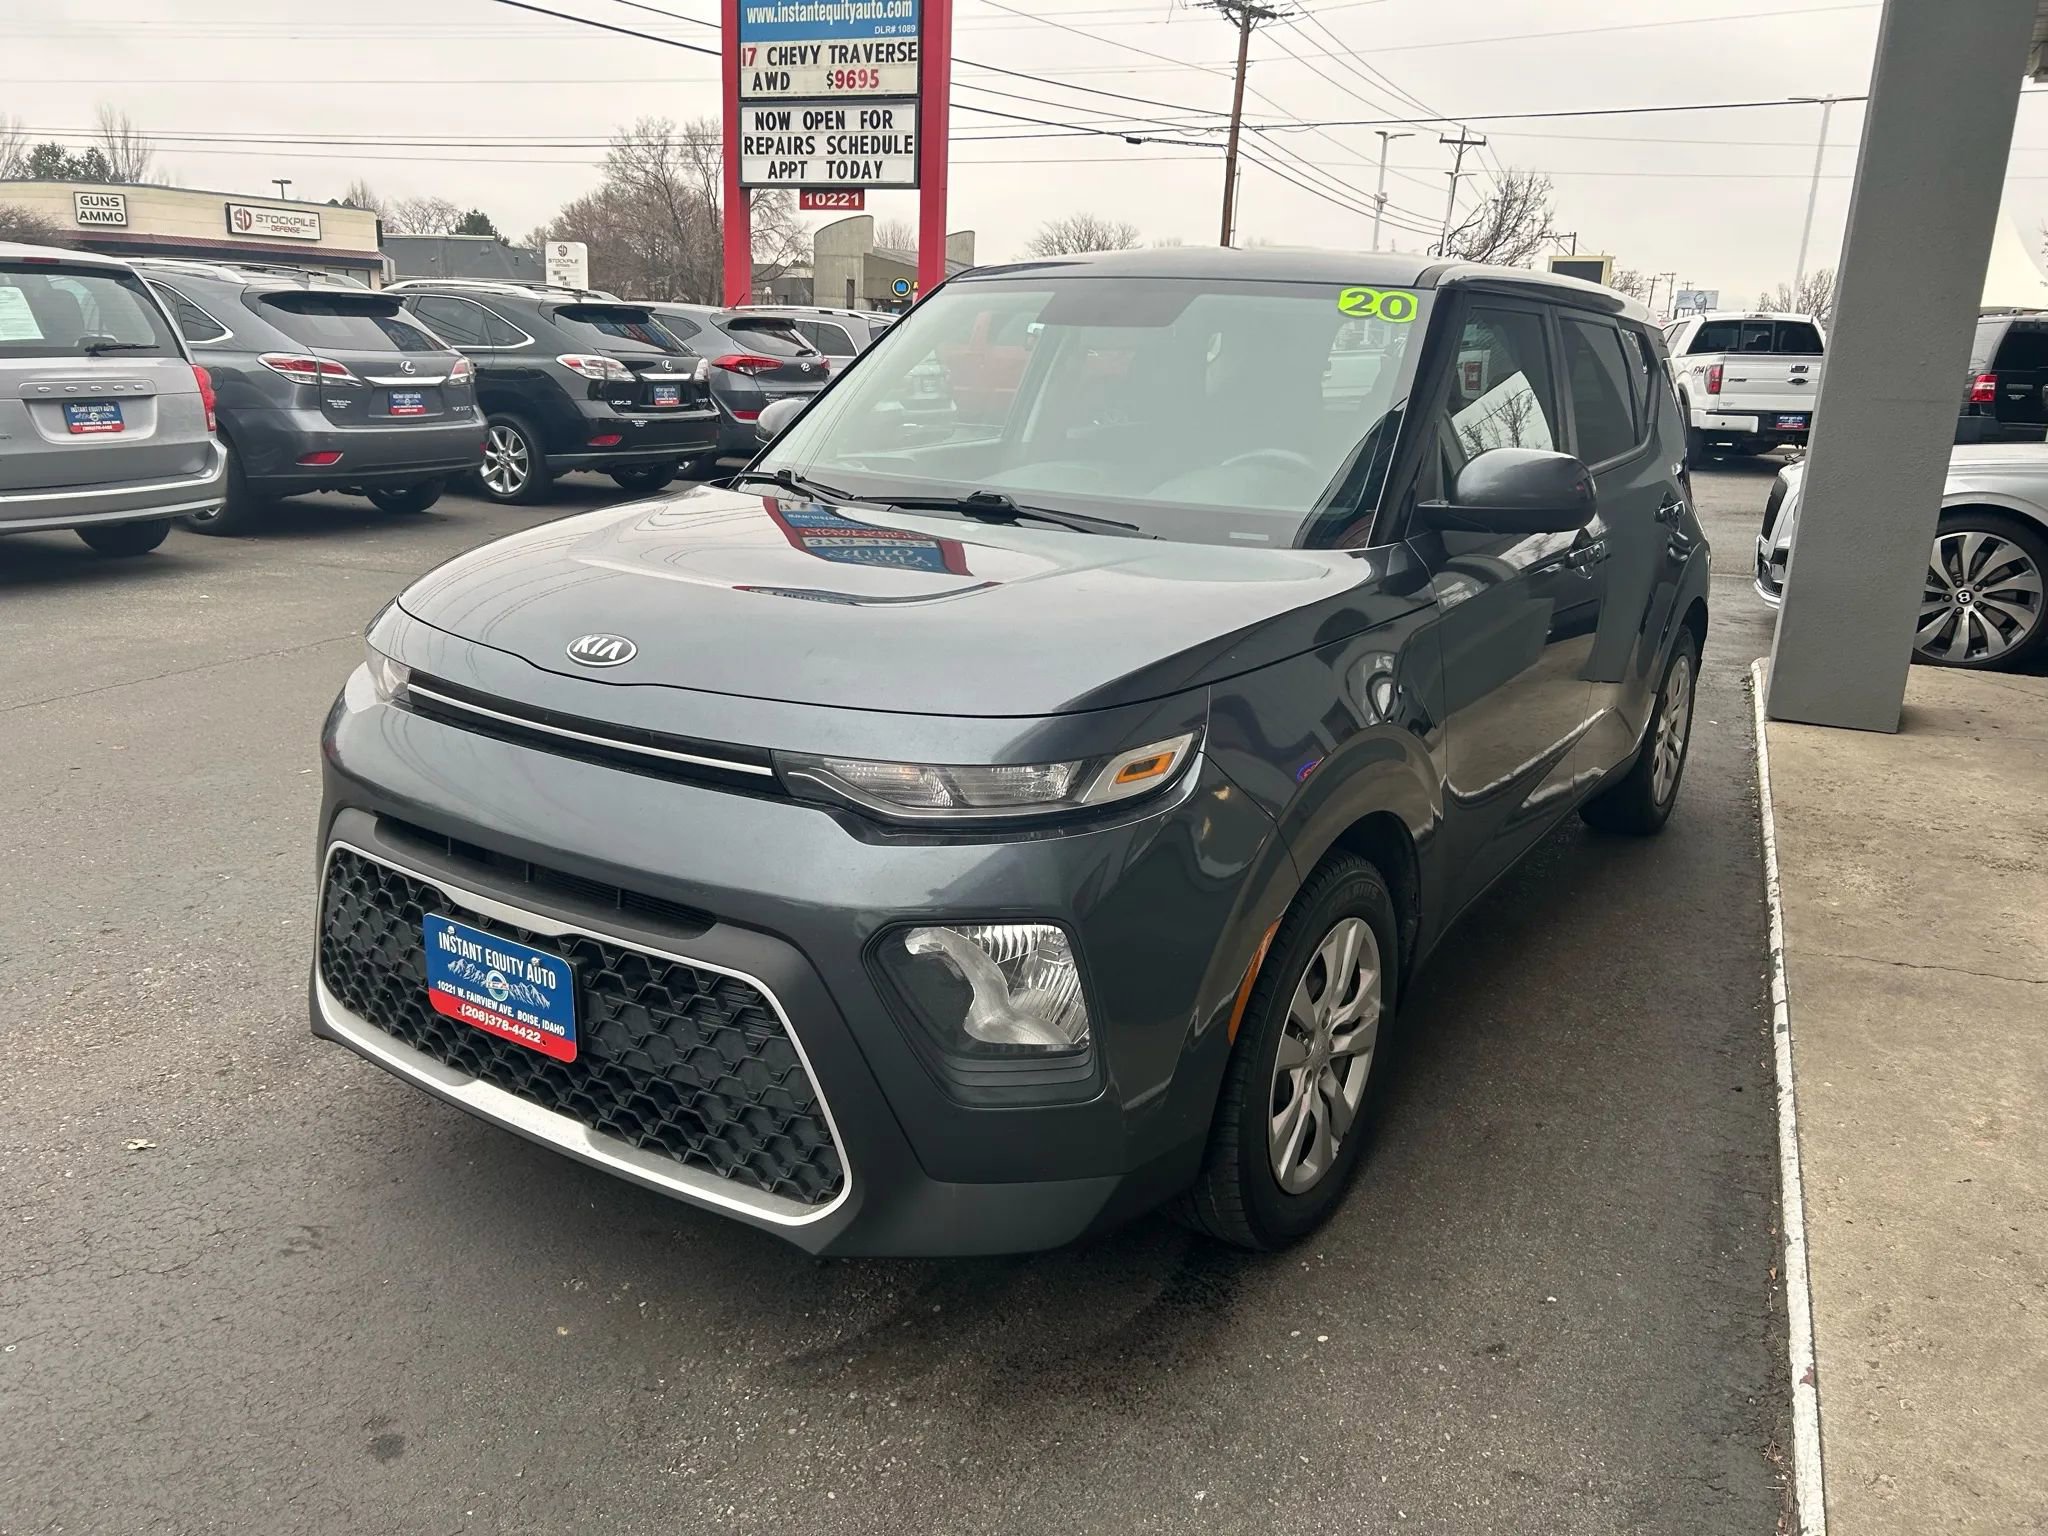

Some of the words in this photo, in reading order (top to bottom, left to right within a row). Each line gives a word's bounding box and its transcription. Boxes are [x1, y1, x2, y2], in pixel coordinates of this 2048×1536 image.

[747, 0, 912, 25] www.instantequityauto.com
[874, 25, 896, 35] DLR#
[898, 24, 916, 33] 1089
[742, 47, 757, 67] 17
[767, 44, 821, 67] CHEVY
[828, 41, 917, 64] TRAVERSE
[752, 71, 791, 91] AWD
[826, 68, 880, 90] $9695
[755, 111, 791, 131] NOW
[802, 110, 846, 130] OPEN
[860, 109, 893, 129] FOR
[744, 135, 816, 155] REPAIRS
[826, 135, 914, 155] SCHEDULE
[767, 160, 808, 179] APPT
[826, 160, 883, 179] TODAY
[80, 195, 120, 207] GUNS
[805, 192, 859, 206] 10221
[79, 210, 124, 222] AMMO
[255, 213, 316, 228] STOCKPILE
[271, 225, 300, 233] DEFENSE
[1344, 290, 1413, 320] 20
[572, 635, 623, 661] KIA
[438, 931, 482, 963] INSTANT
[485, 947, 524, 977] EQUITY
[526, 962, 556, 990] AUTO
[437, 980, 456, 994] 10221
[457, 987, 466, 998] W.
[466, 990, 498, 1010] FAIRVIEW
[498, 1003, 514, 1018] AVE.
[517, 1010, 541, 1029] BOISE,
[542, 1019, 565, 1036] IDAHO
[461, 1003, 541, 1043] (208)378-4422
